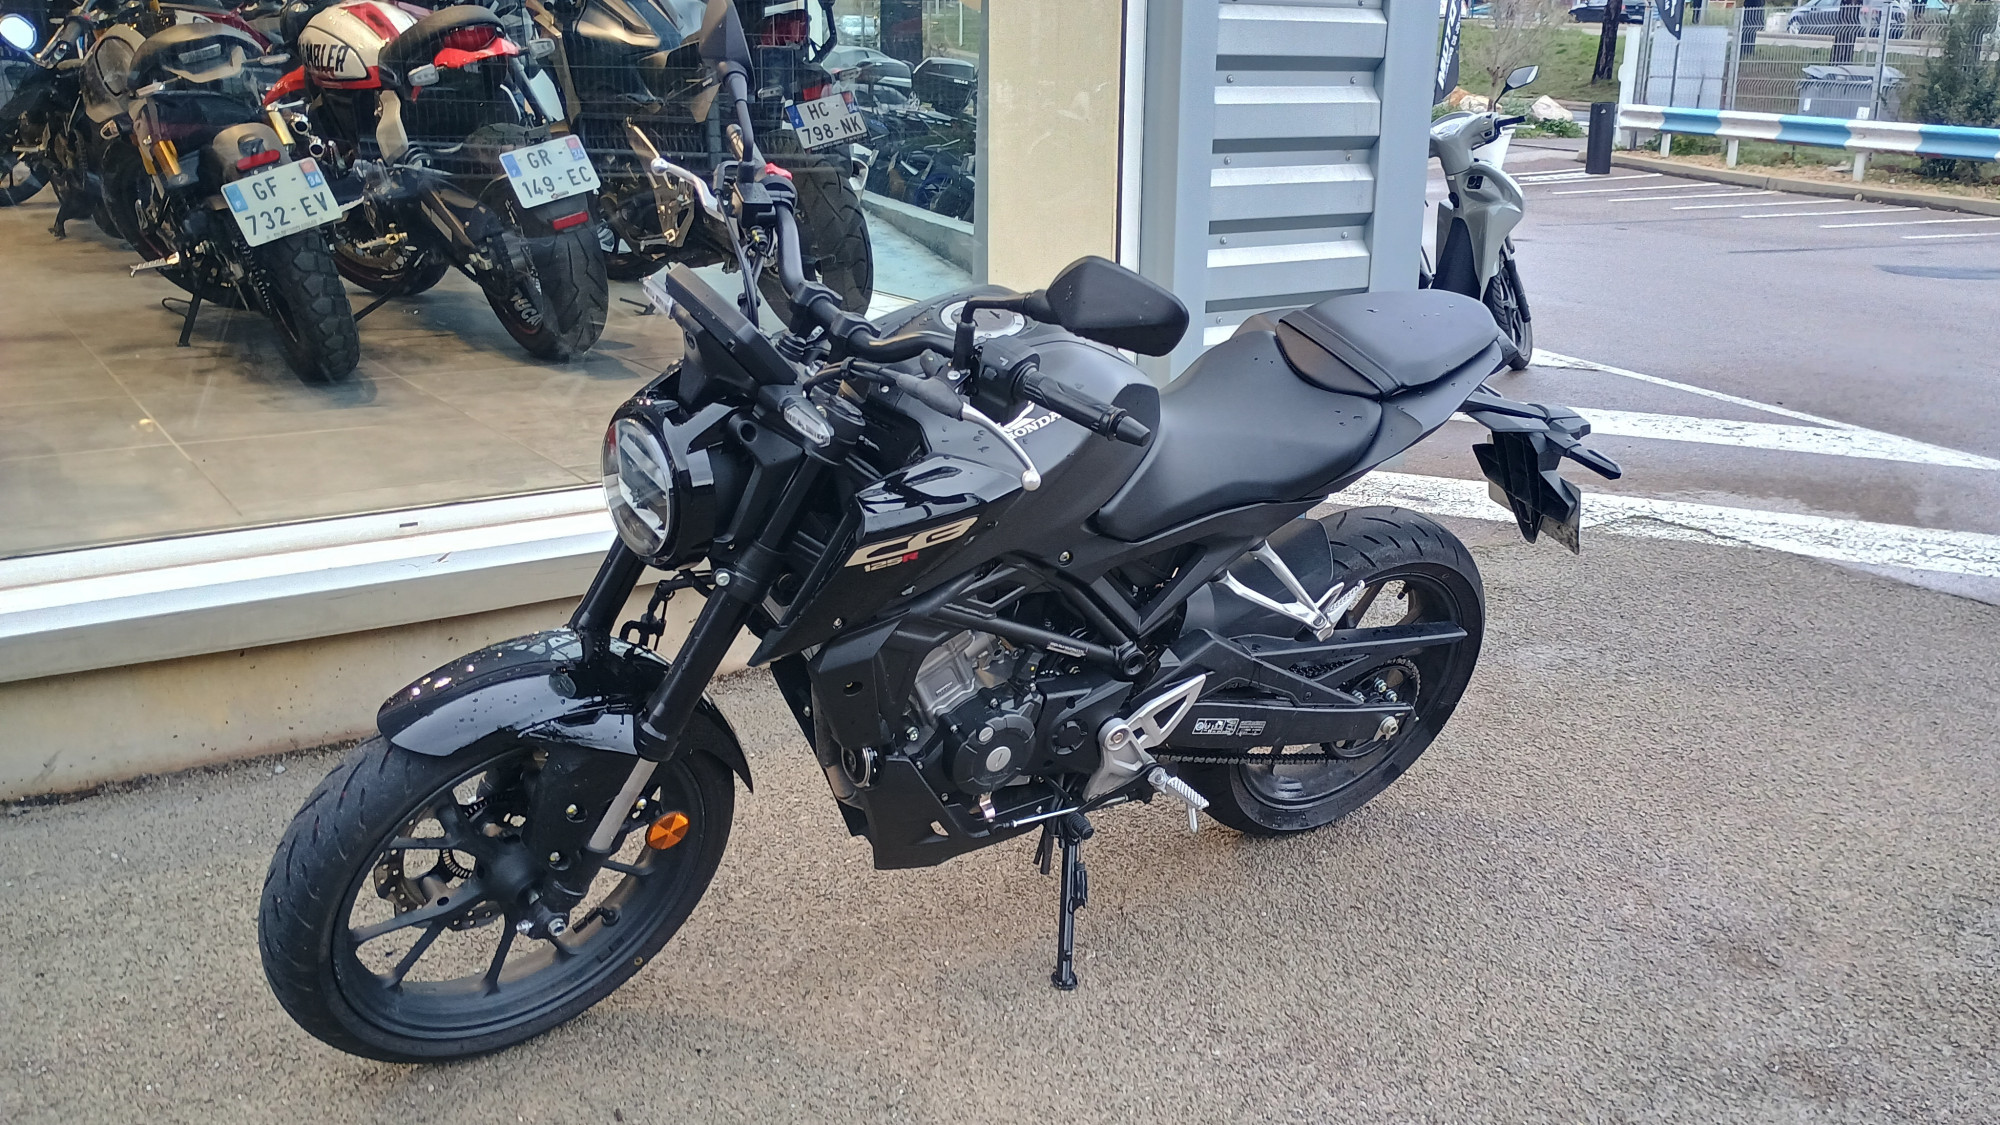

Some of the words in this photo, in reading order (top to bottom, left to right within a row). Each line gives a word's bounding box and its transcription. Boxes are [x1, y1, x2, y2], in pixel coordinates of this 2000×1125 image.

[807, 101, 830, 120] HC
[801, 116, 862, 145] 798-NK
[526, 149, 552, 169] GR
[252, 176, 277, 201] GF
[307, 173, 322, 187] 34
[521, 166, 592, 198] 149-EC
[244, 192, 328, 236] 732-EV
[844, 516, 979, 567] CB
